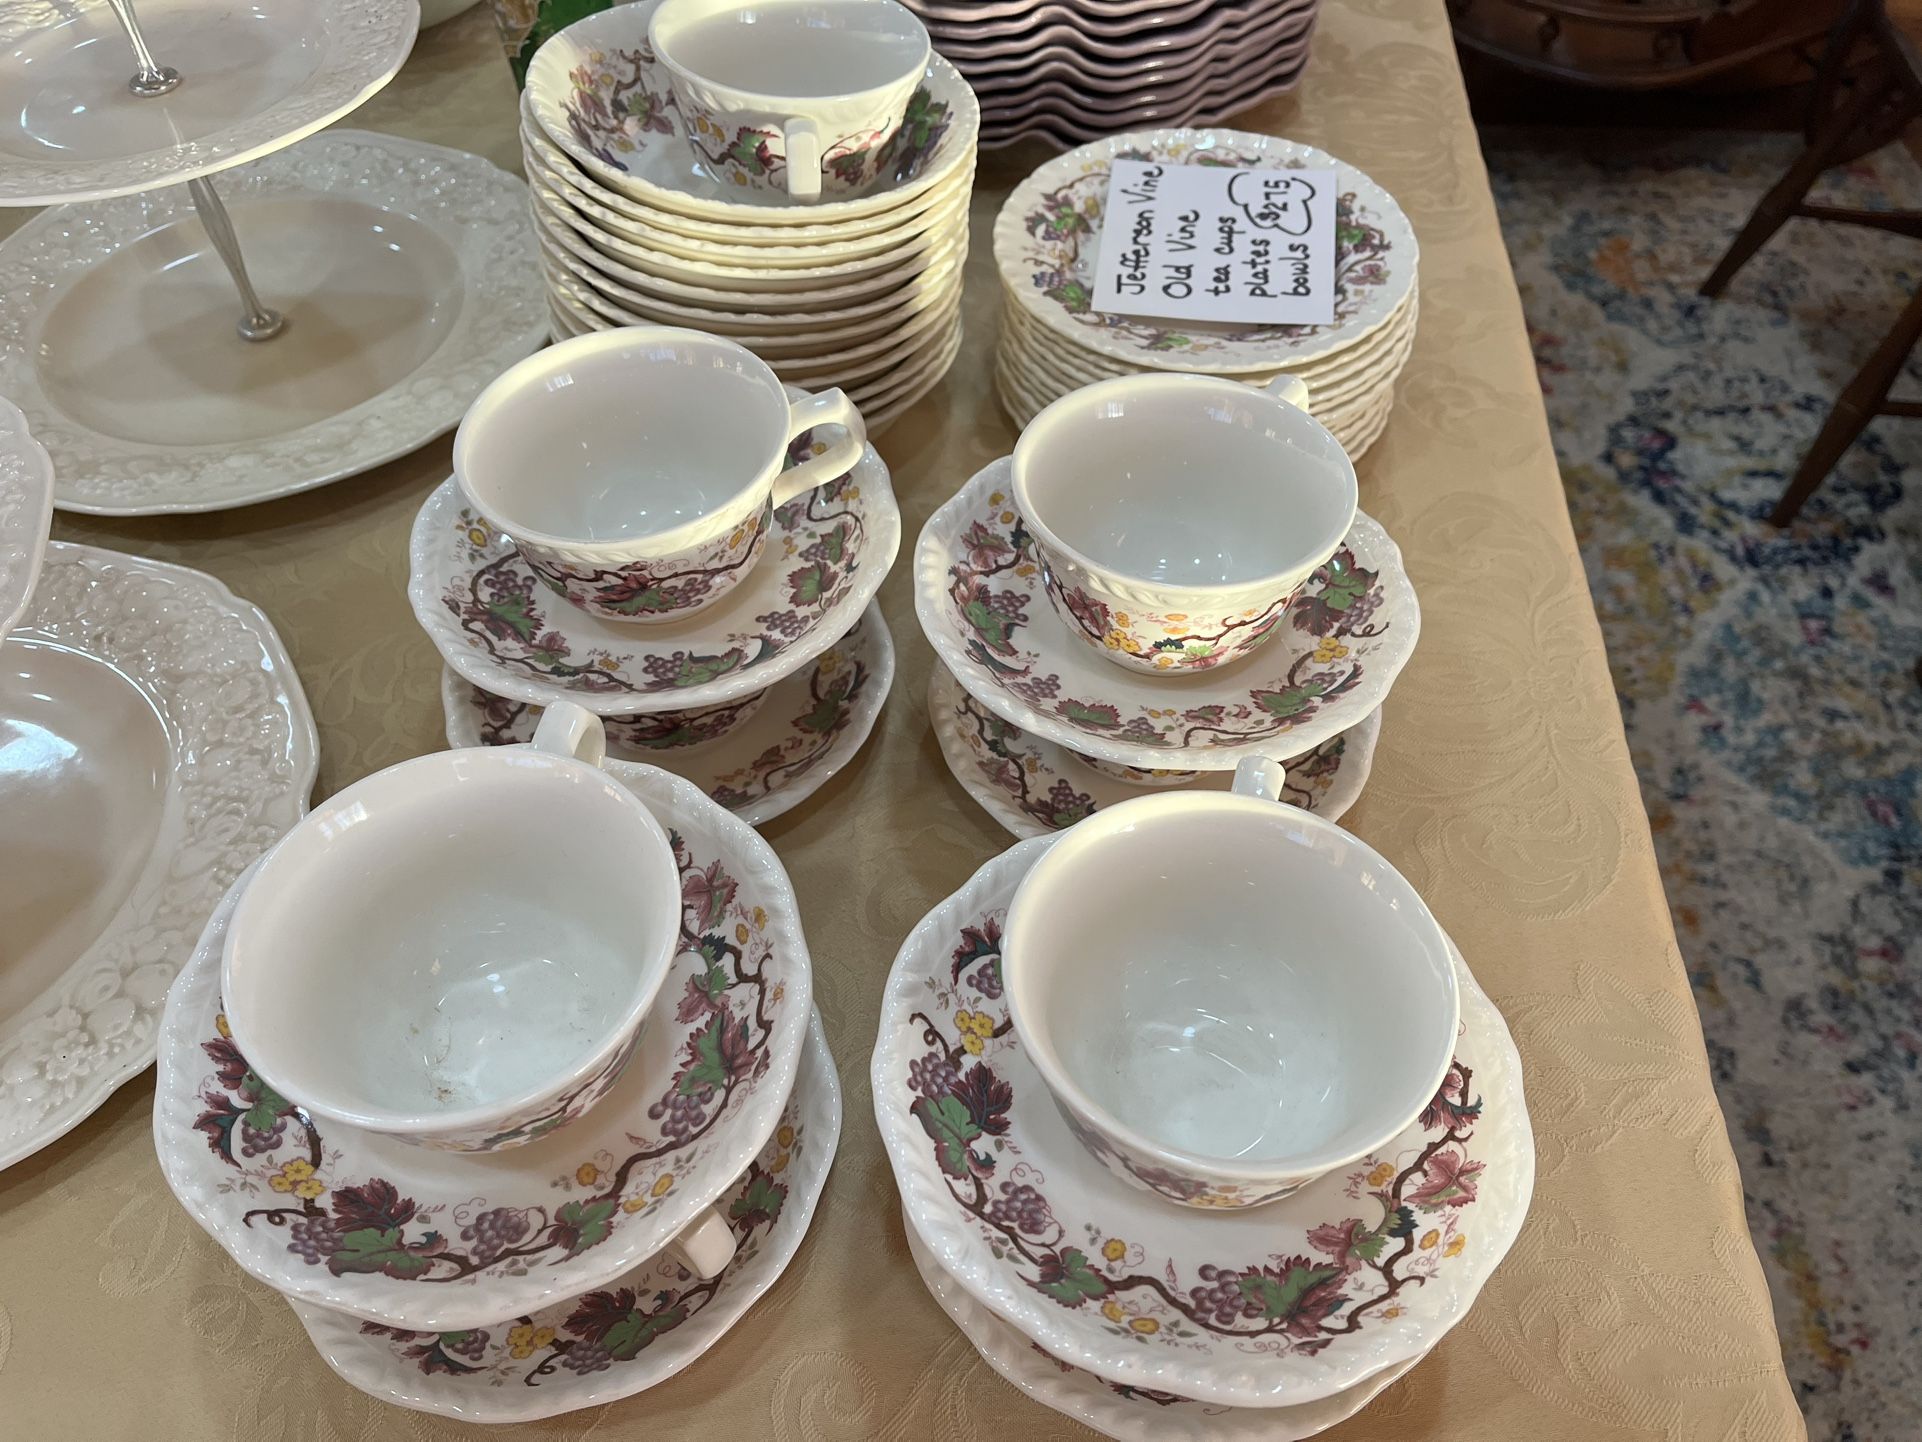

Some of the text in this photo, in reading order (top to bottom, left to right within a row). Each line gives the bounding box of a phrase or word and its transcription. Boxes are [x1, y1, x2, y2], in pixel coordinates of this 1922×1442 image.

[1116, 166, 1164, 295] Jefferson Vine
[1162, 210, 1200, 299] Old Vine
[1205, 216, 1246, 296] tea cups
[1242, 239, 1278, 298] plates
[1278, 243, 1311, 296] bowls
